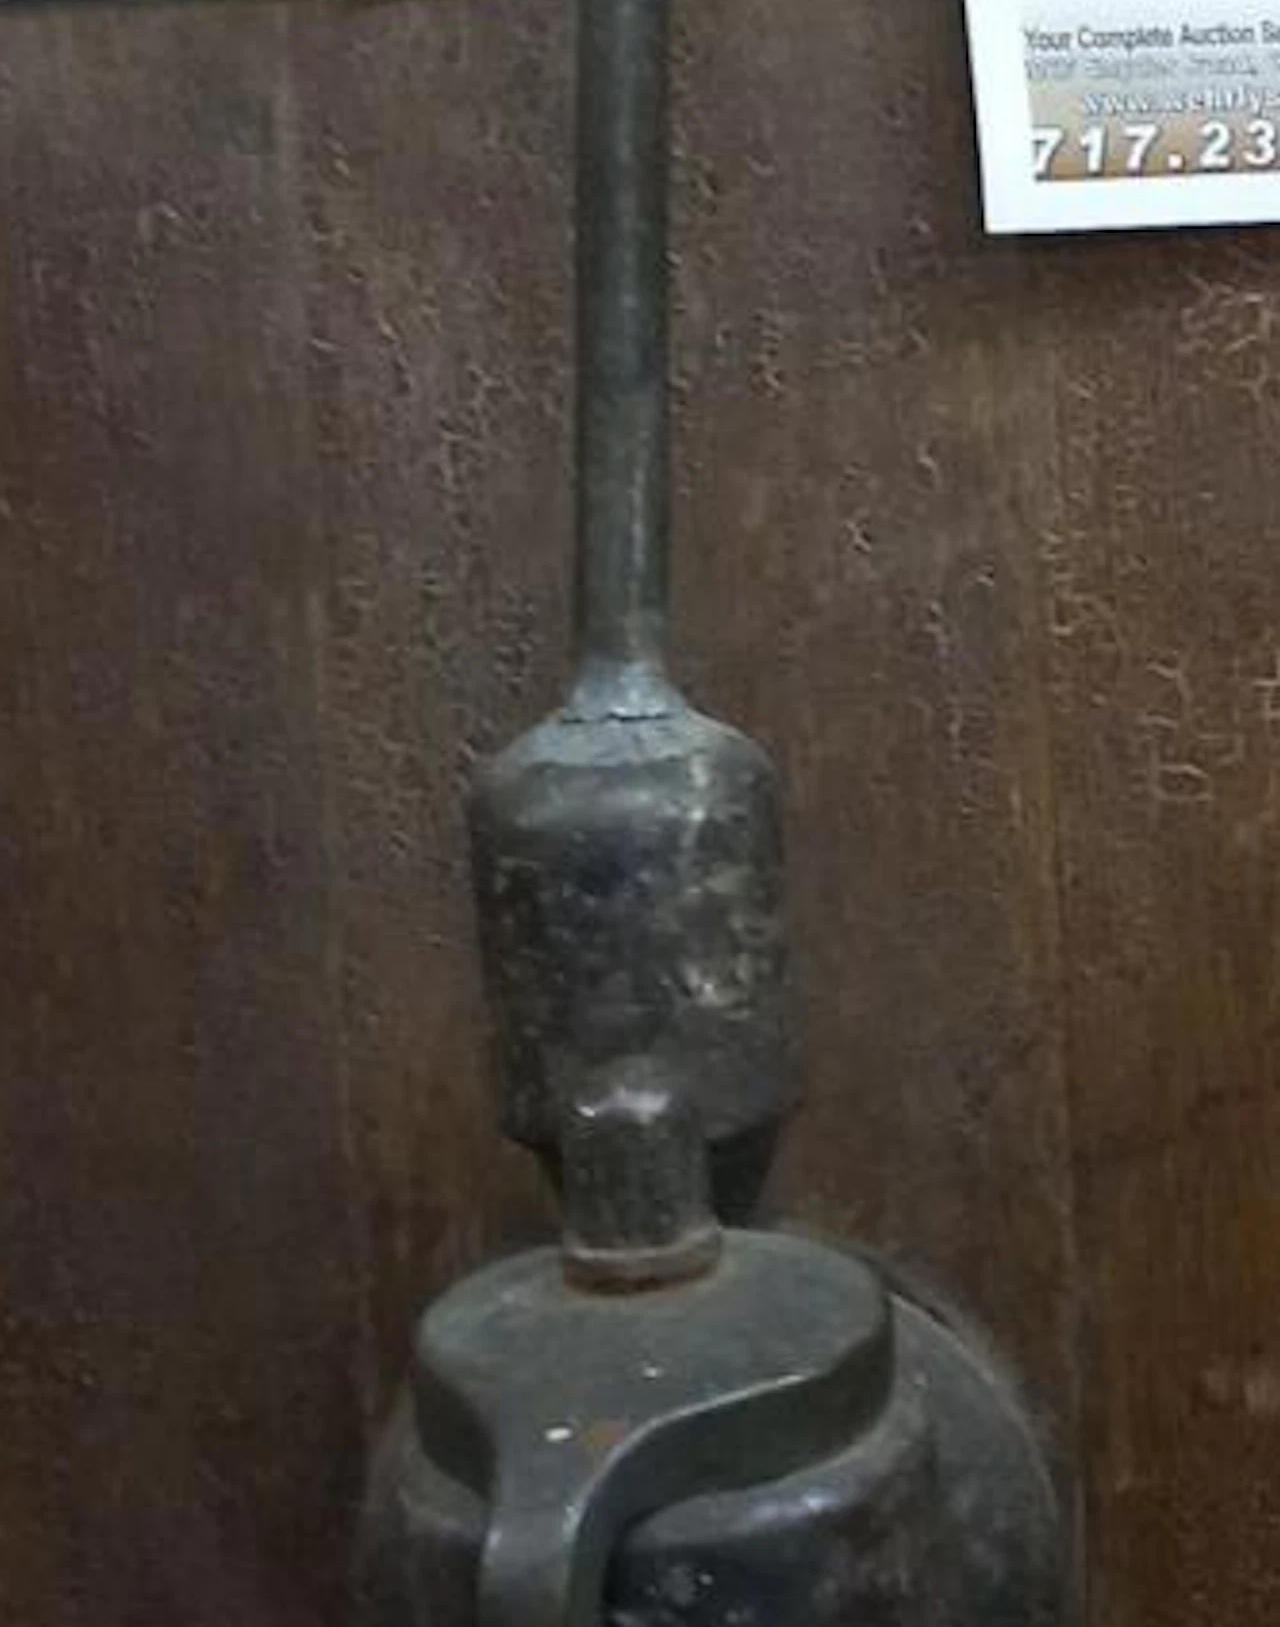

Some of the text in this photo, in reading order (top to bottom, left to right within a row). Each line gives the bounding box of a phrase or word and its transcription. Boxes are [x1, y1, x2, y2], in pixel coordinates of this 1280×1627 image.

[1024, 30, 1070, 50] Your
[1077, 25, 1173, 53] Complete
[1181, 23, 1255, 45] Auction
